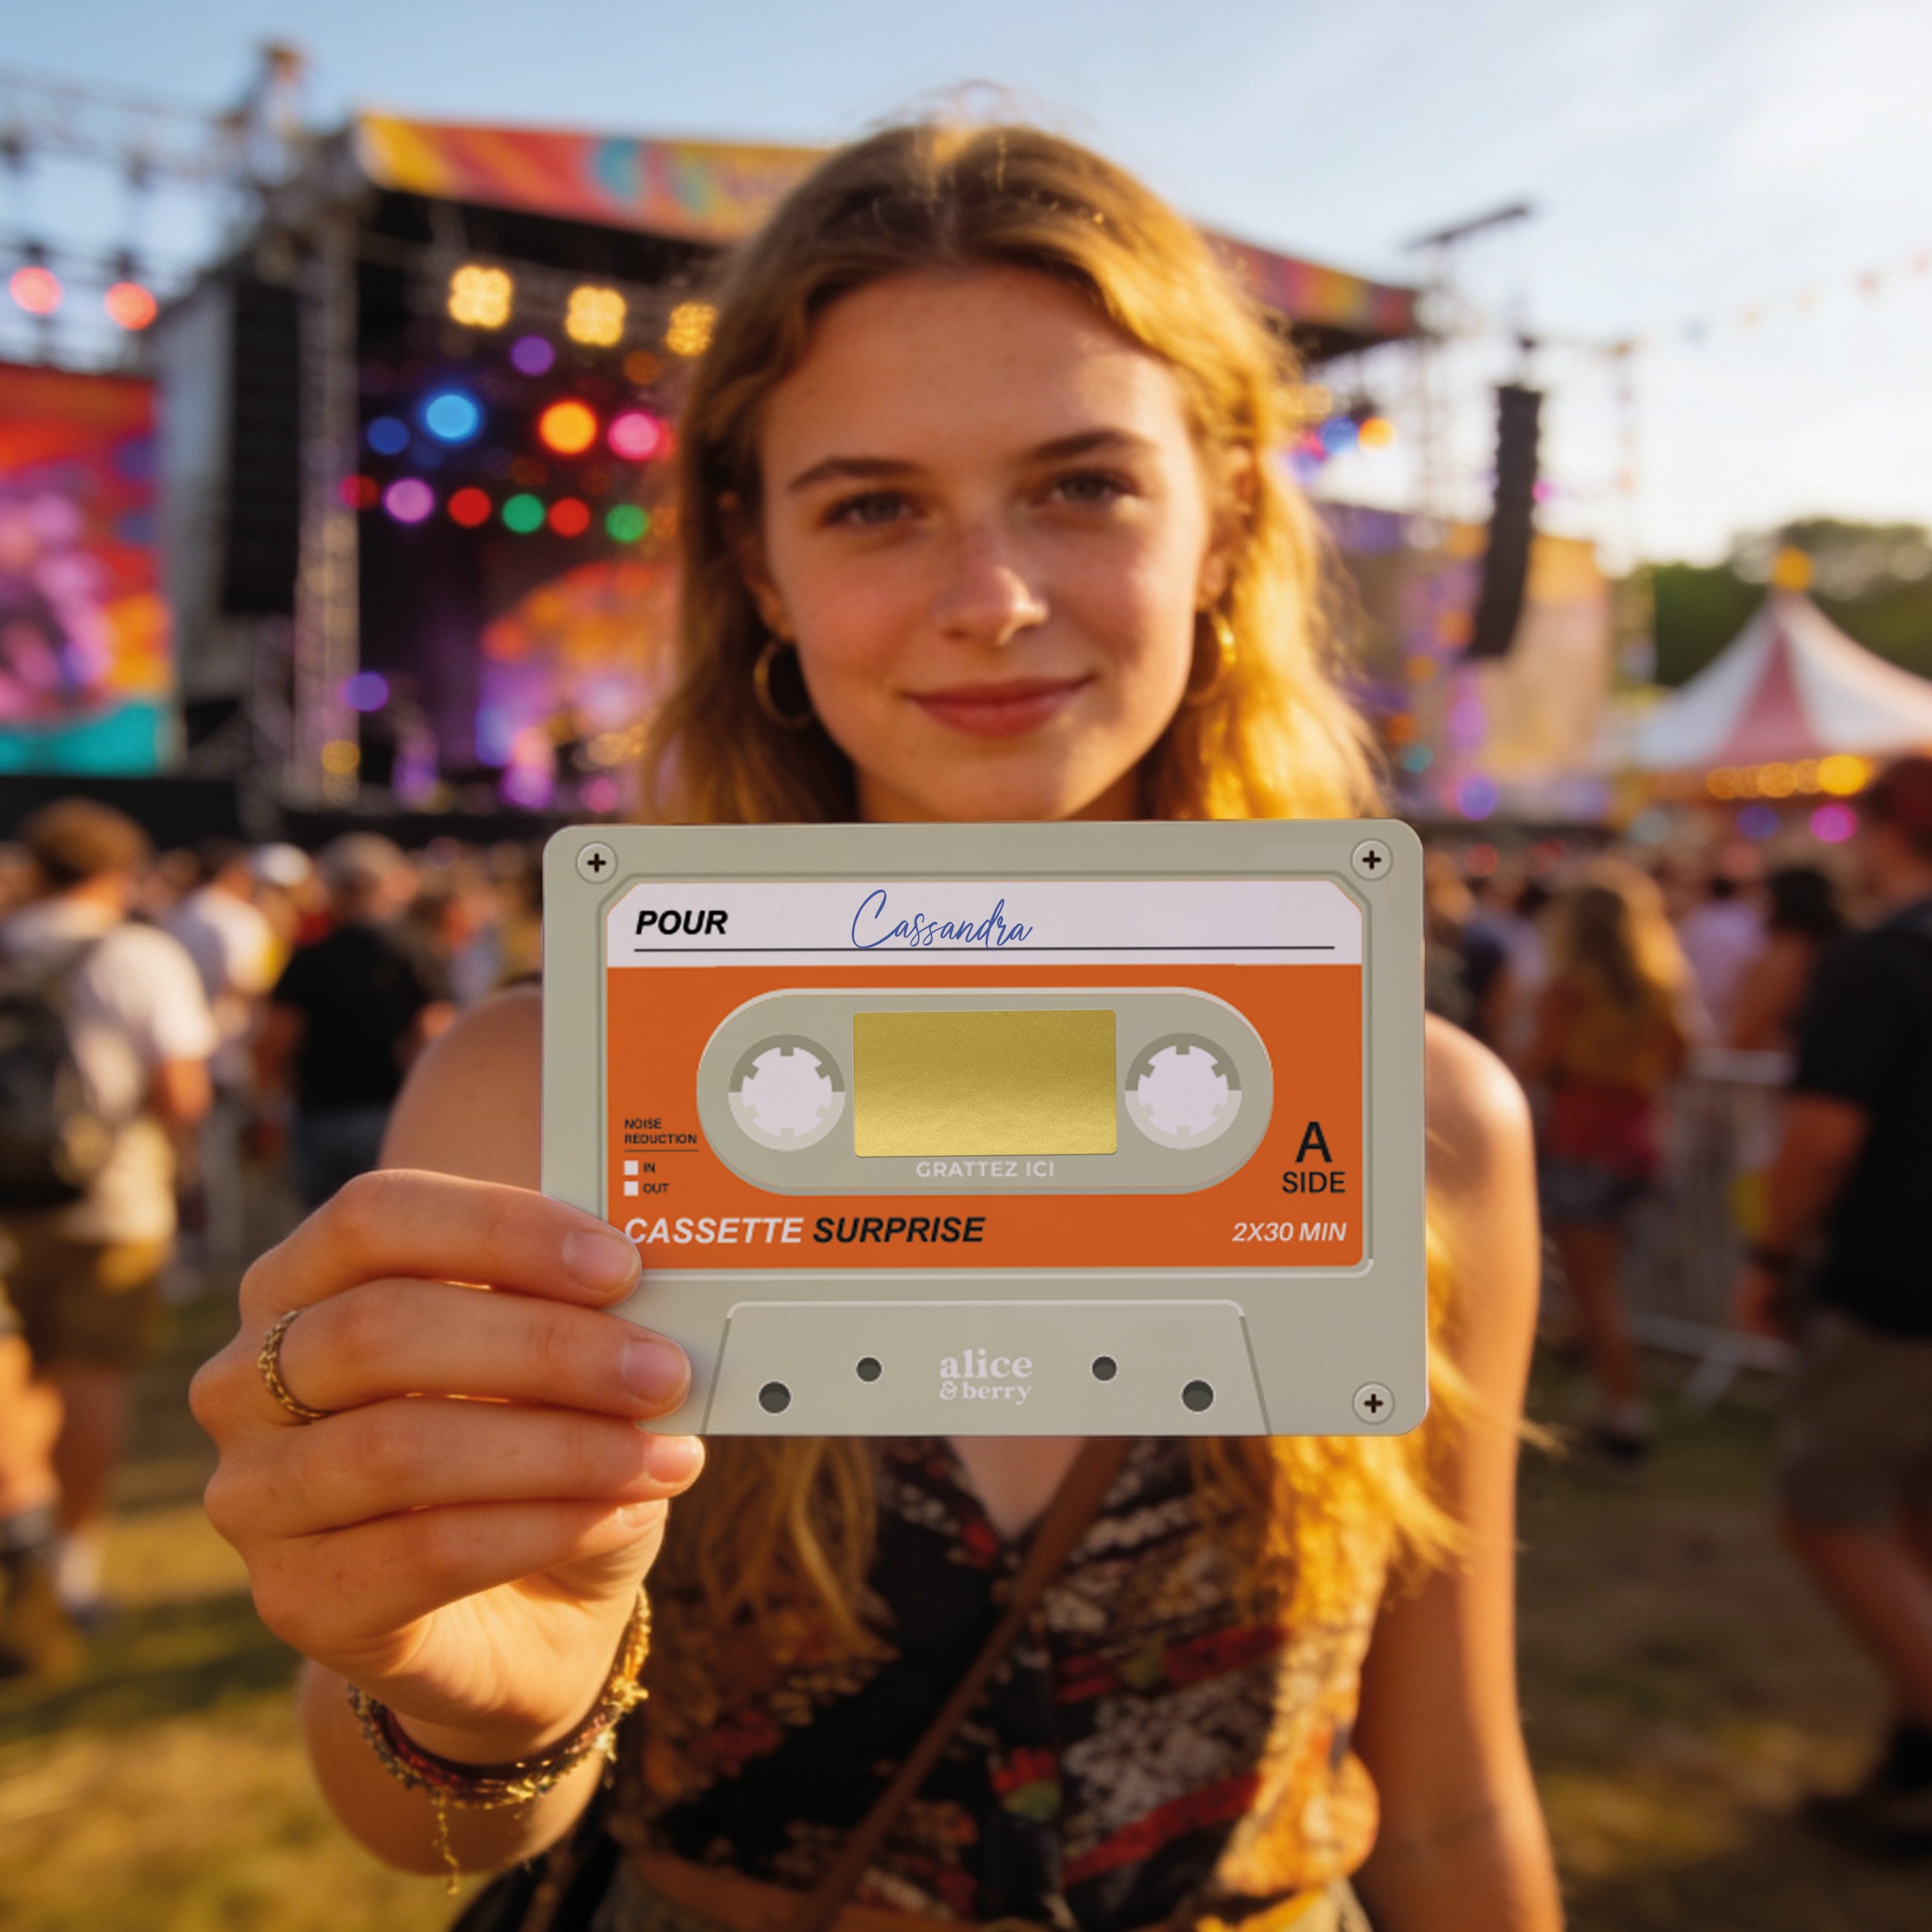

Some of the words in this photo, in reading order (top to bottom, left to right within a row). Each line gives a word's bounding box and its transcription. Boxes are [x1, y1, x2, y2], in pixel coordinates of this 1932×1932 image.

[635, 910, 728, 936] POUR
[852, 889, 1033, 949] Cassandra
[624, 1118, 662, 1130] NOISE
[624, 1134, 697, 1145] REDUCTION
[1295, 1121, 1332, 1162] A
[644, 1162, 655, 1173] IN
[916, 1161, 1019, 1178] GRATTEZ
[1026, 1161, 1055, 1177] ICI
[643, 1182, 668, 1193] OUT
[1282, 1171, 1345, 1193] SIDE
[624, 1217, 804, 1244] CASSETTE
[813, 1216, 986, 1243] SURPRISE
[1232, 1222, 1294, 1243] 2X30
[1298, 1222, 1347, 1242] MIN
[939, 1349, 1032, 1379] alice
[939, 1382, 957, 1400] &
[963, 1381, 1032, 1405] berry
